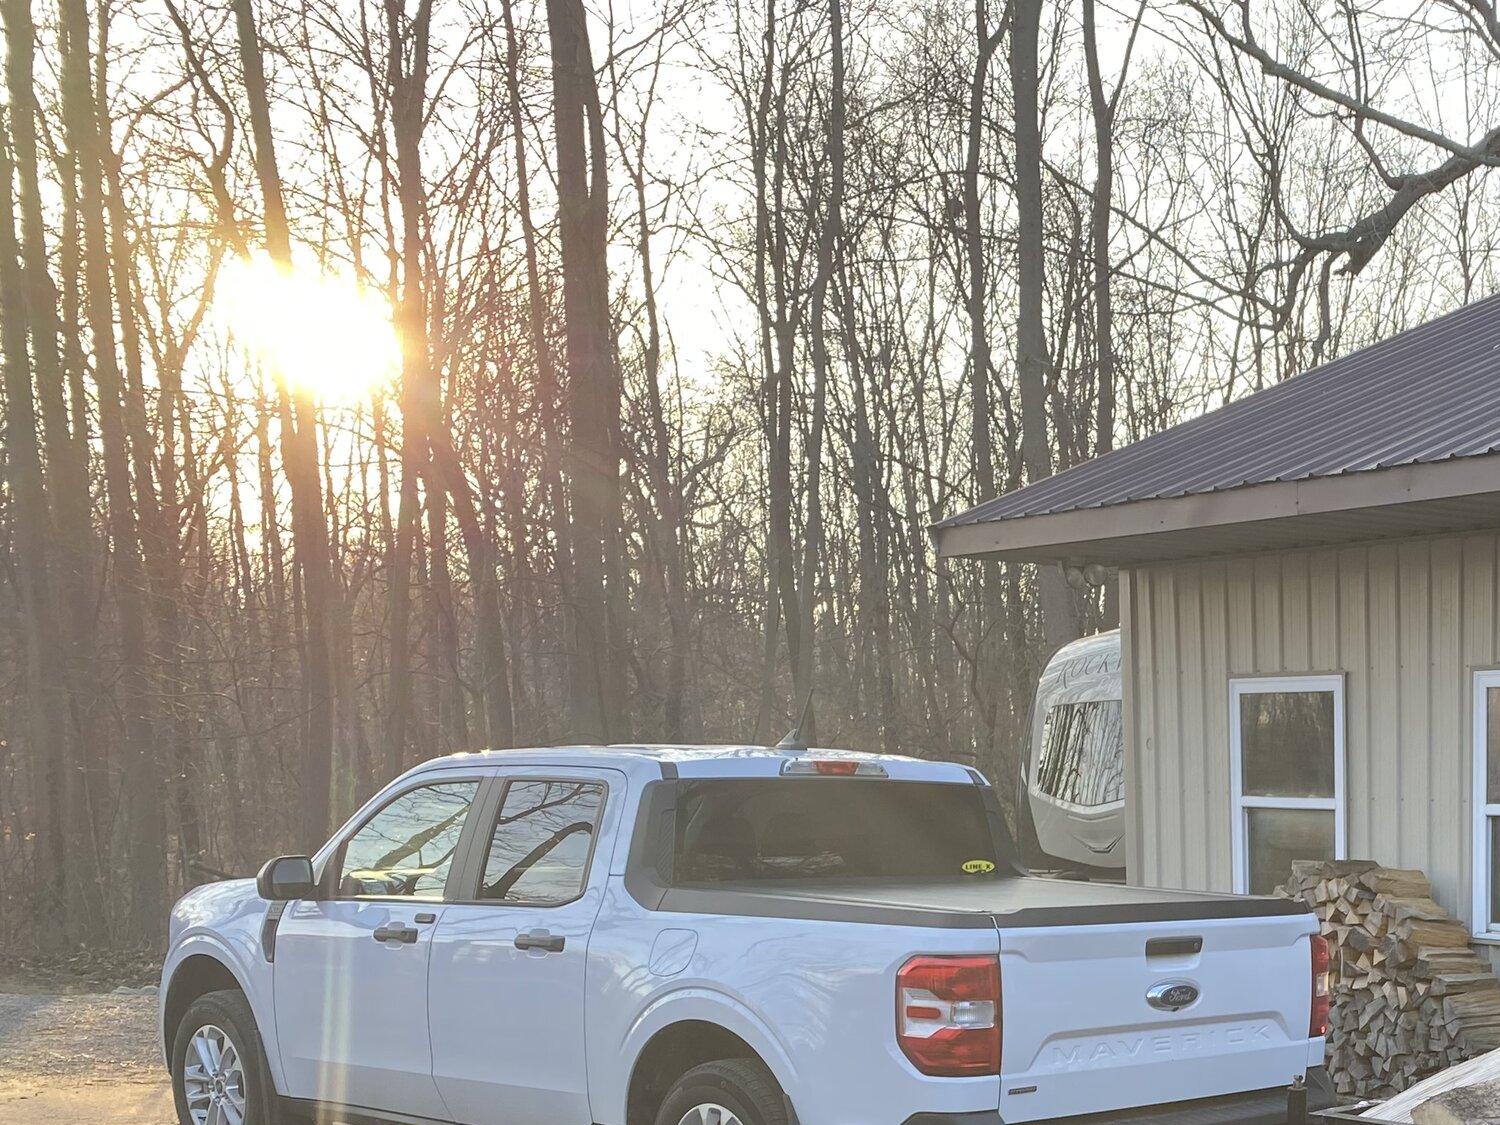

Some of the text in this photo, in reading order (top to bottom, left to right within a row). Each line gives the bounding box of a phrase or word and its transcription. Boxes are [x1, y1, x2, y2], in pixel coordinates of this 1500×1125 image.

[1056, 653, 1121, 689] ROCK
[1169, 988, 1194, 1001] Ford
[1053, 1024, 1271, 1066] MAVERICK
